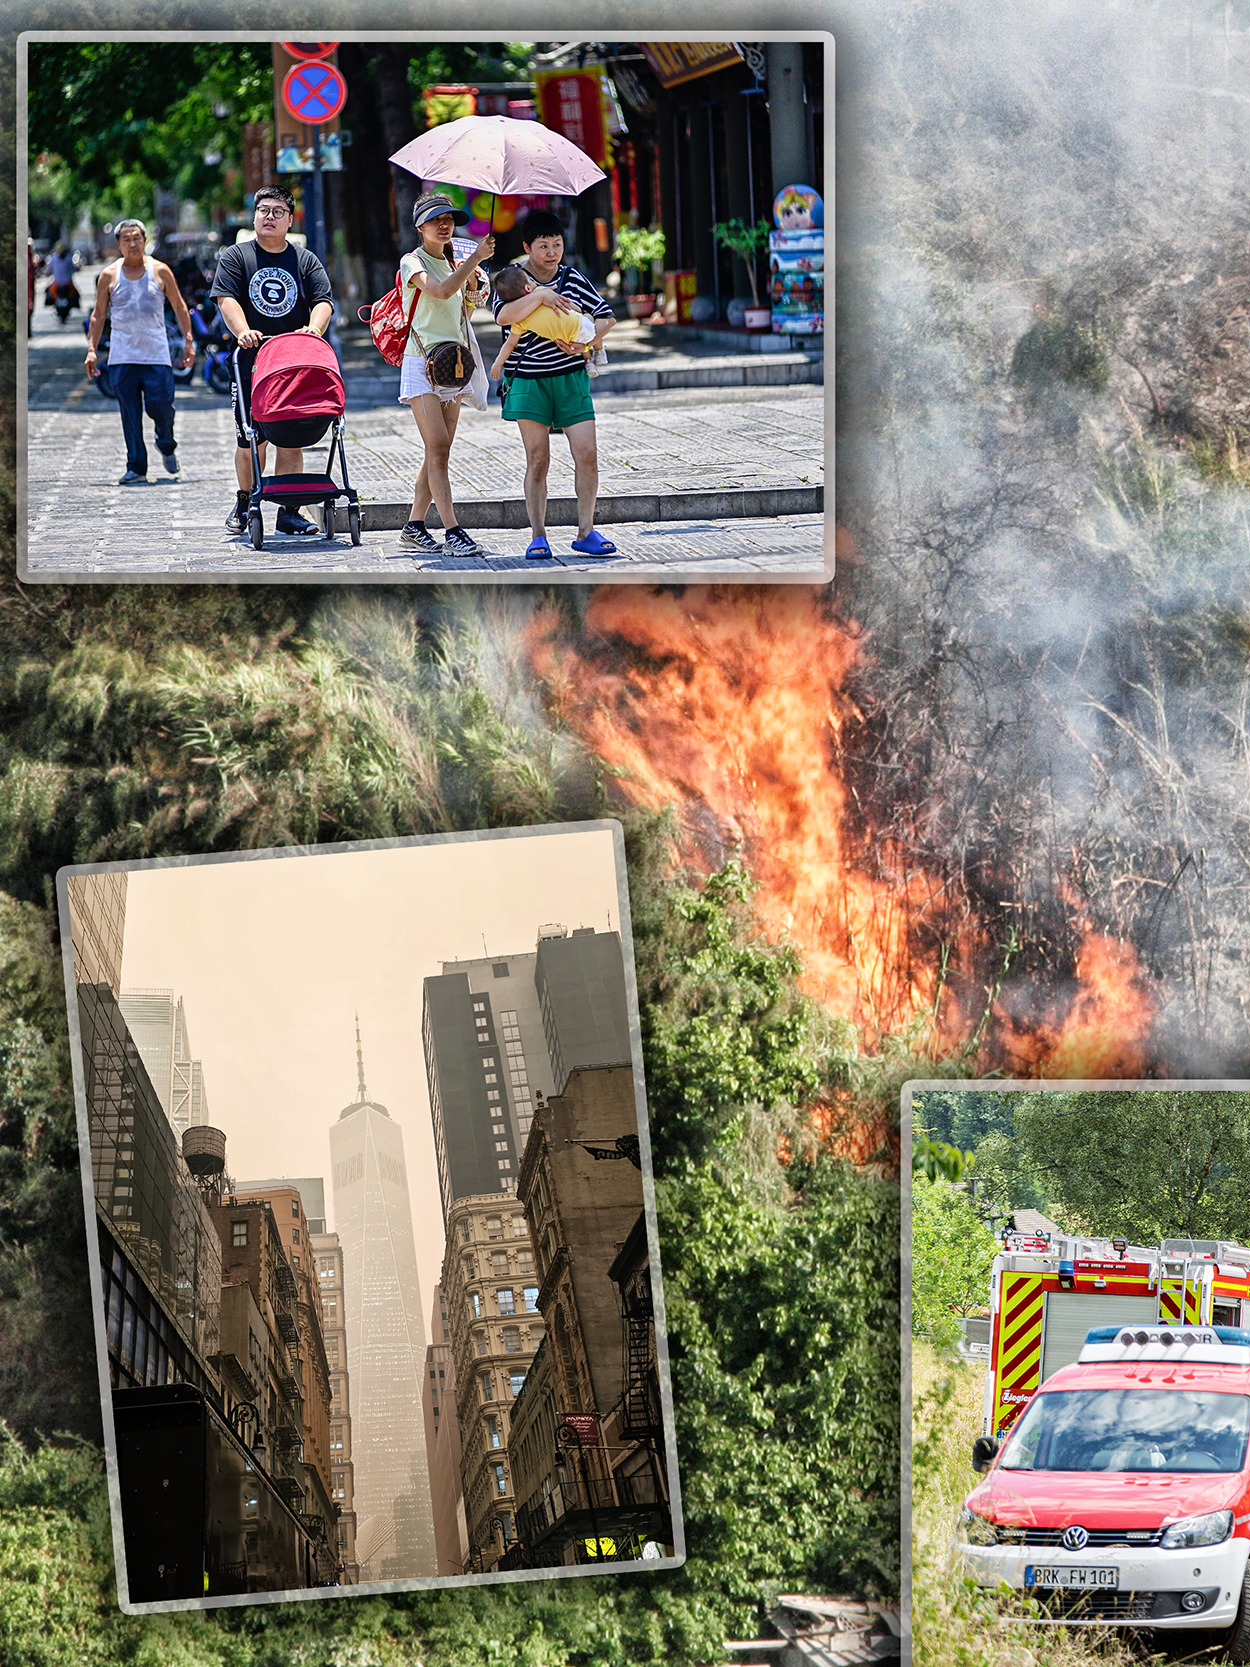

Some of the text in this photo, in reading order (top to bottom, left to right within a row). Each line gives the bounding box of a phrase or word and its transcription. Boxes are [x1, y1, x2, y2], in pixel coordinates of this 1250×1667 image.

[1034, 1568, 1115, 1585] BRK FW 101
